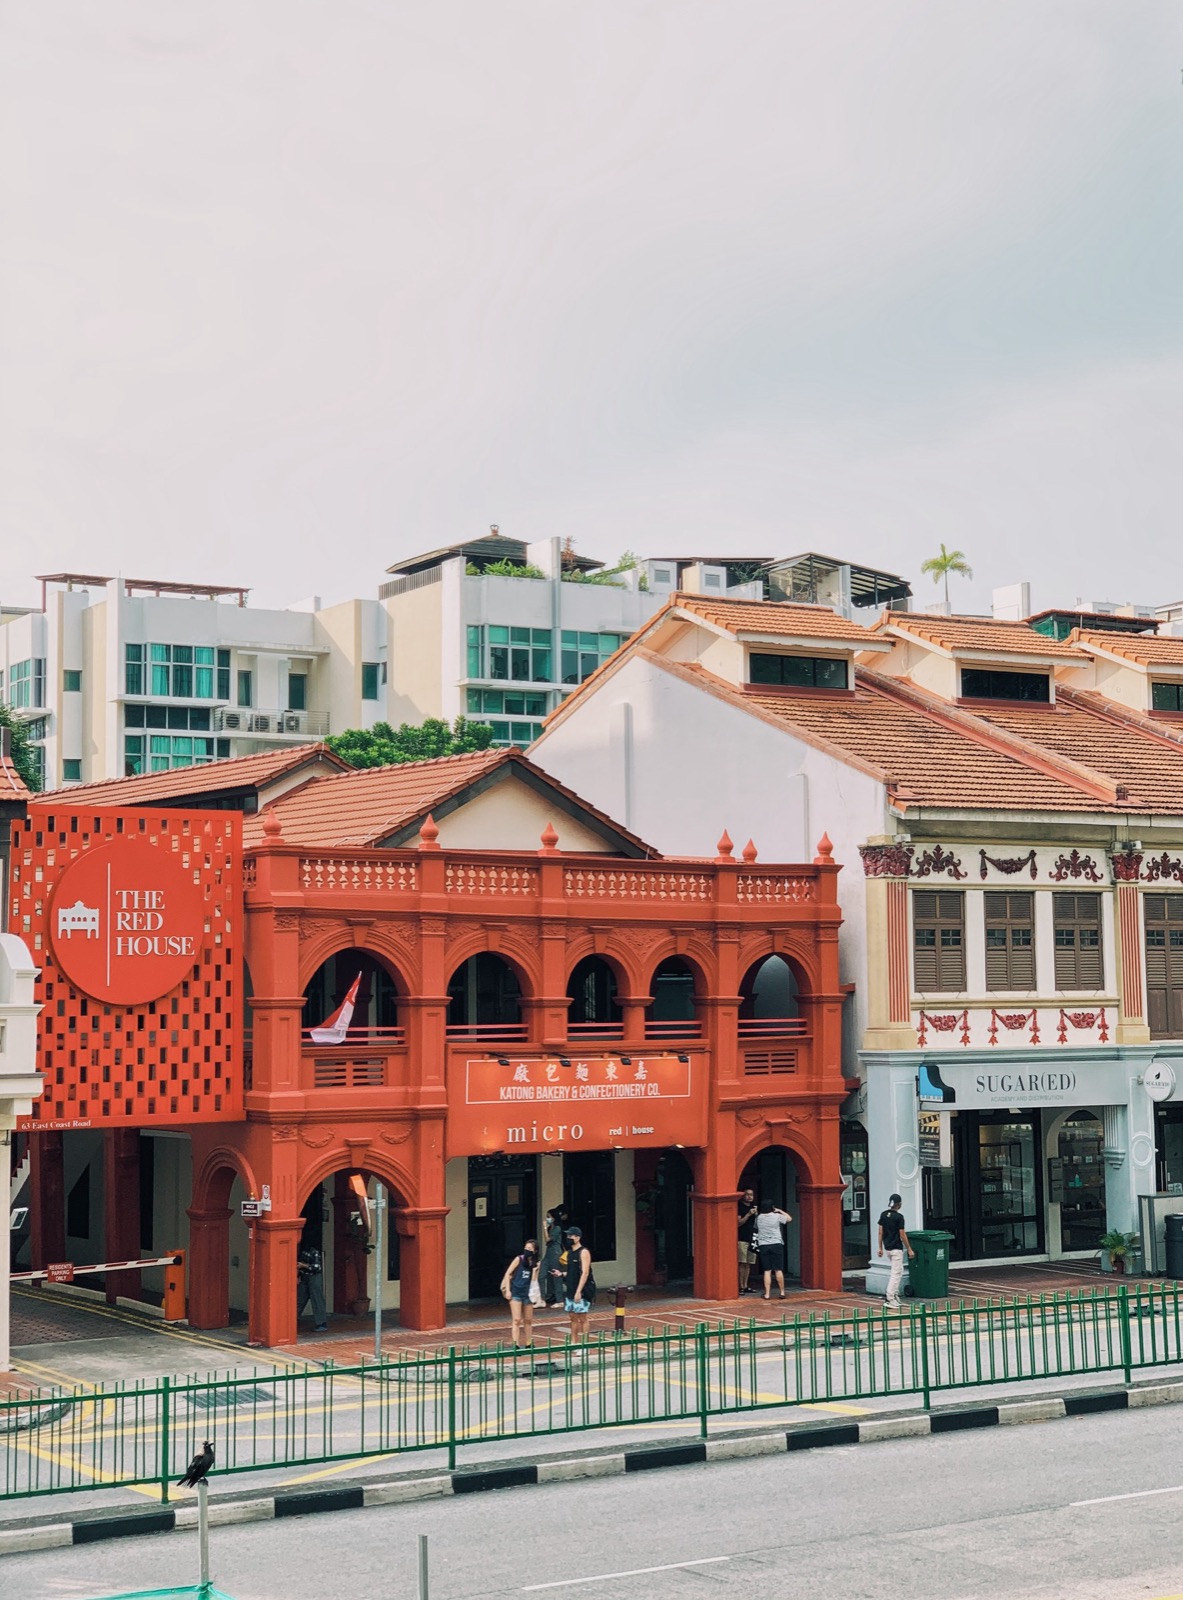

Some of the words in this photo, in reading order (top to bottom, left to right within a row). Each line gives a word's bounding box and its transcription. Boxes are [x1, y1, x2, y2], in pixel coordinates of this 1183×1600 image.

[115, 890, 166, 910] THE
[115, 911, 164, 931] RED
[115, 935, 195, 956] HOUSE
[499, 1086, 535, 1100] KATONG
[536, 1085, 571, 1099] BAKERY
[571, 1085, 577, 1099] &
[579, 1083, 647, 1098] CONFECTIONERY
[647, 1082, 660, 1096] CO.
[976, 1070, 1076, 1093] SUGAR(ED)
[1028, 1094, 1064, 1102] DISTRIBUTION
[21, 1122, 30, 1130] 63
[50, 1121, 70, 1129] Coast
[506, 1120, 584, 1143] micro
[609, 1126, 622, 1136] red
[632, 1125, 654, 1135] house
